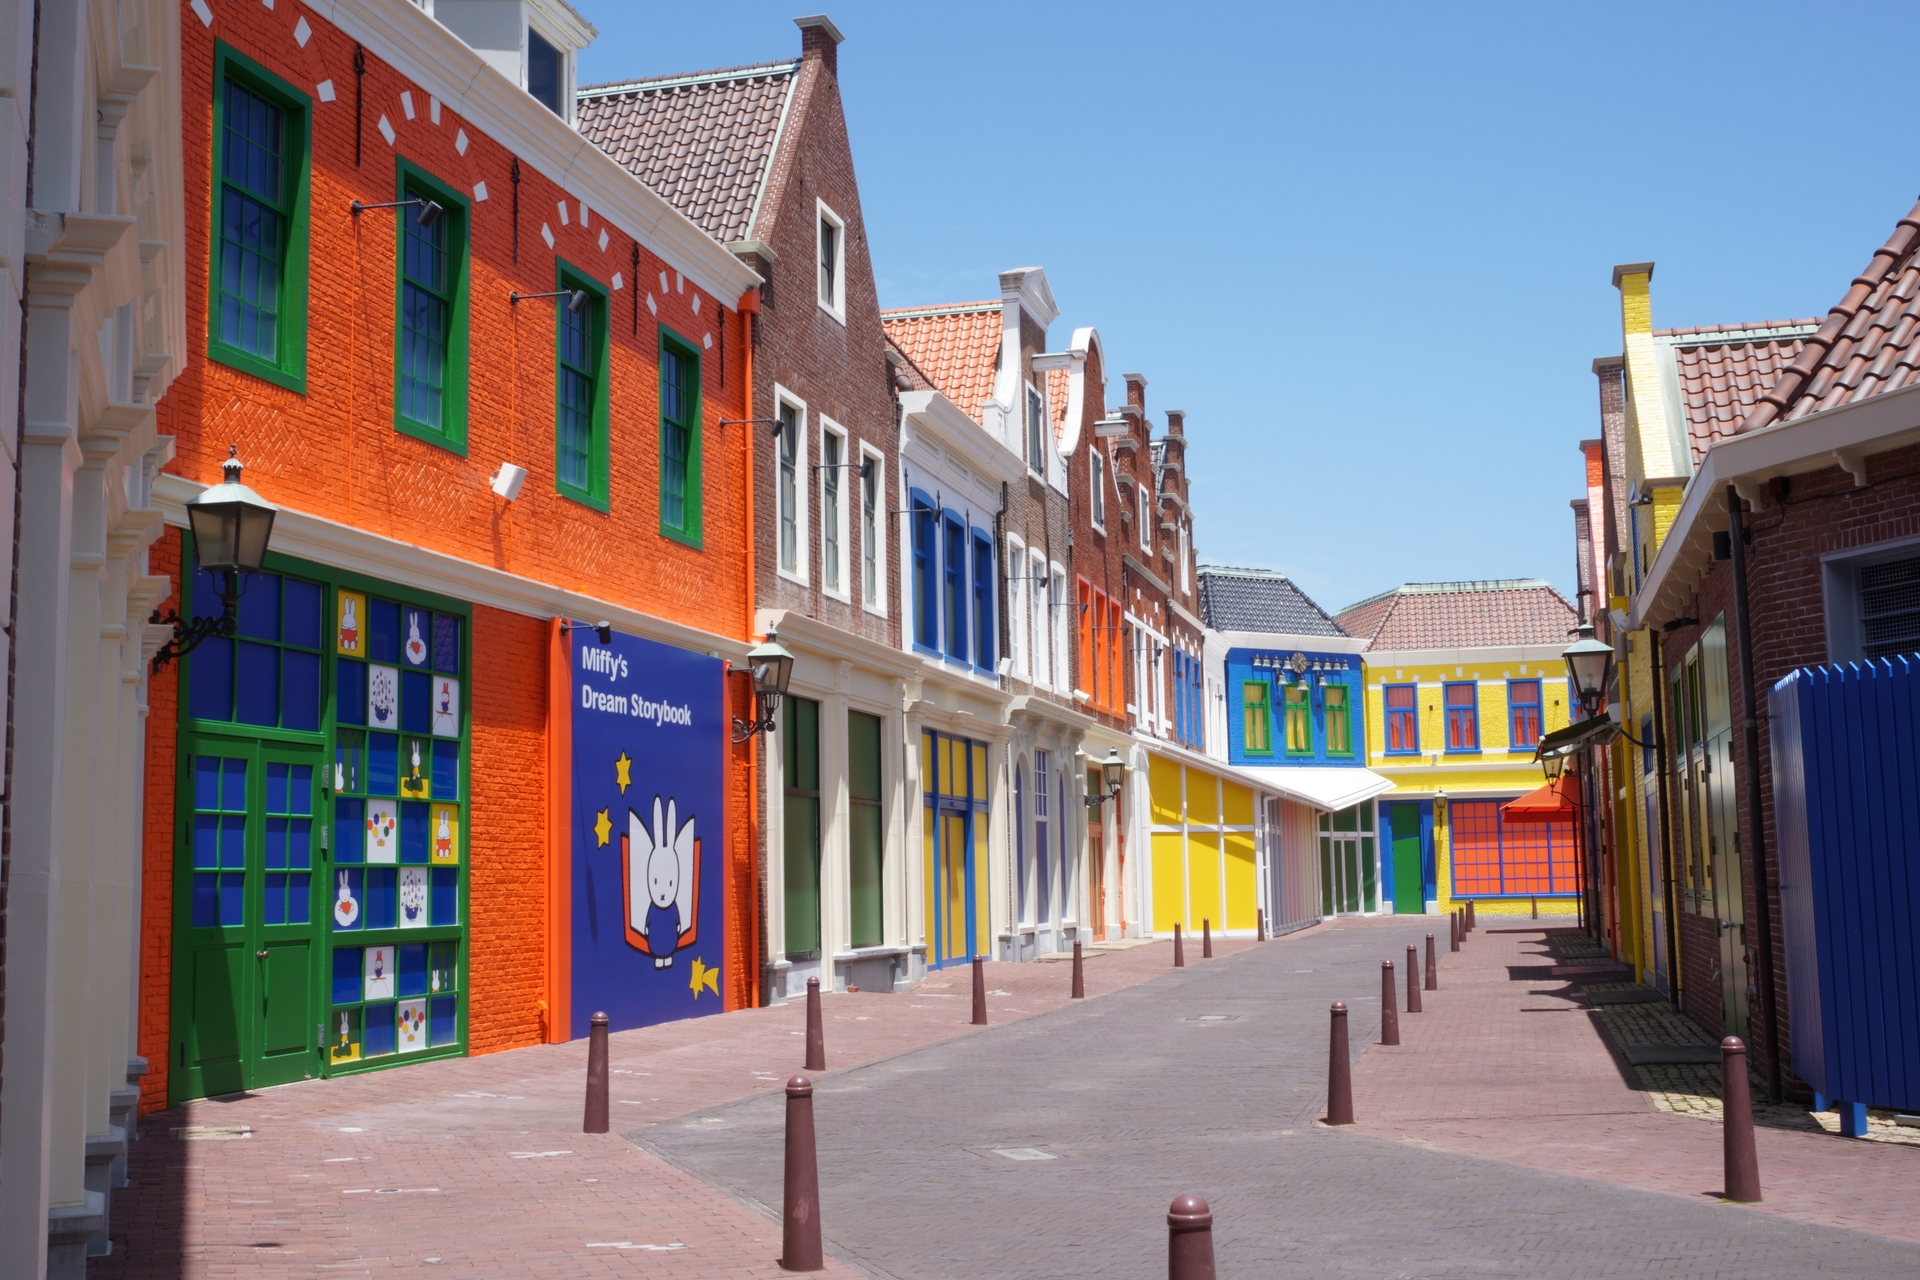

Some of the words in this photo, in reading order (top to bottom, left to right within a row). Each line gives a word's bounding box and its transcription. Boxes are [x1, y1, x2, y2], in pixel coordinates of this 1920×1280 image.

[582, 645, 628, 682] Miffy's
[582, 684, 627, 715] Dream
[630, 693, 692, 727] Storybook
